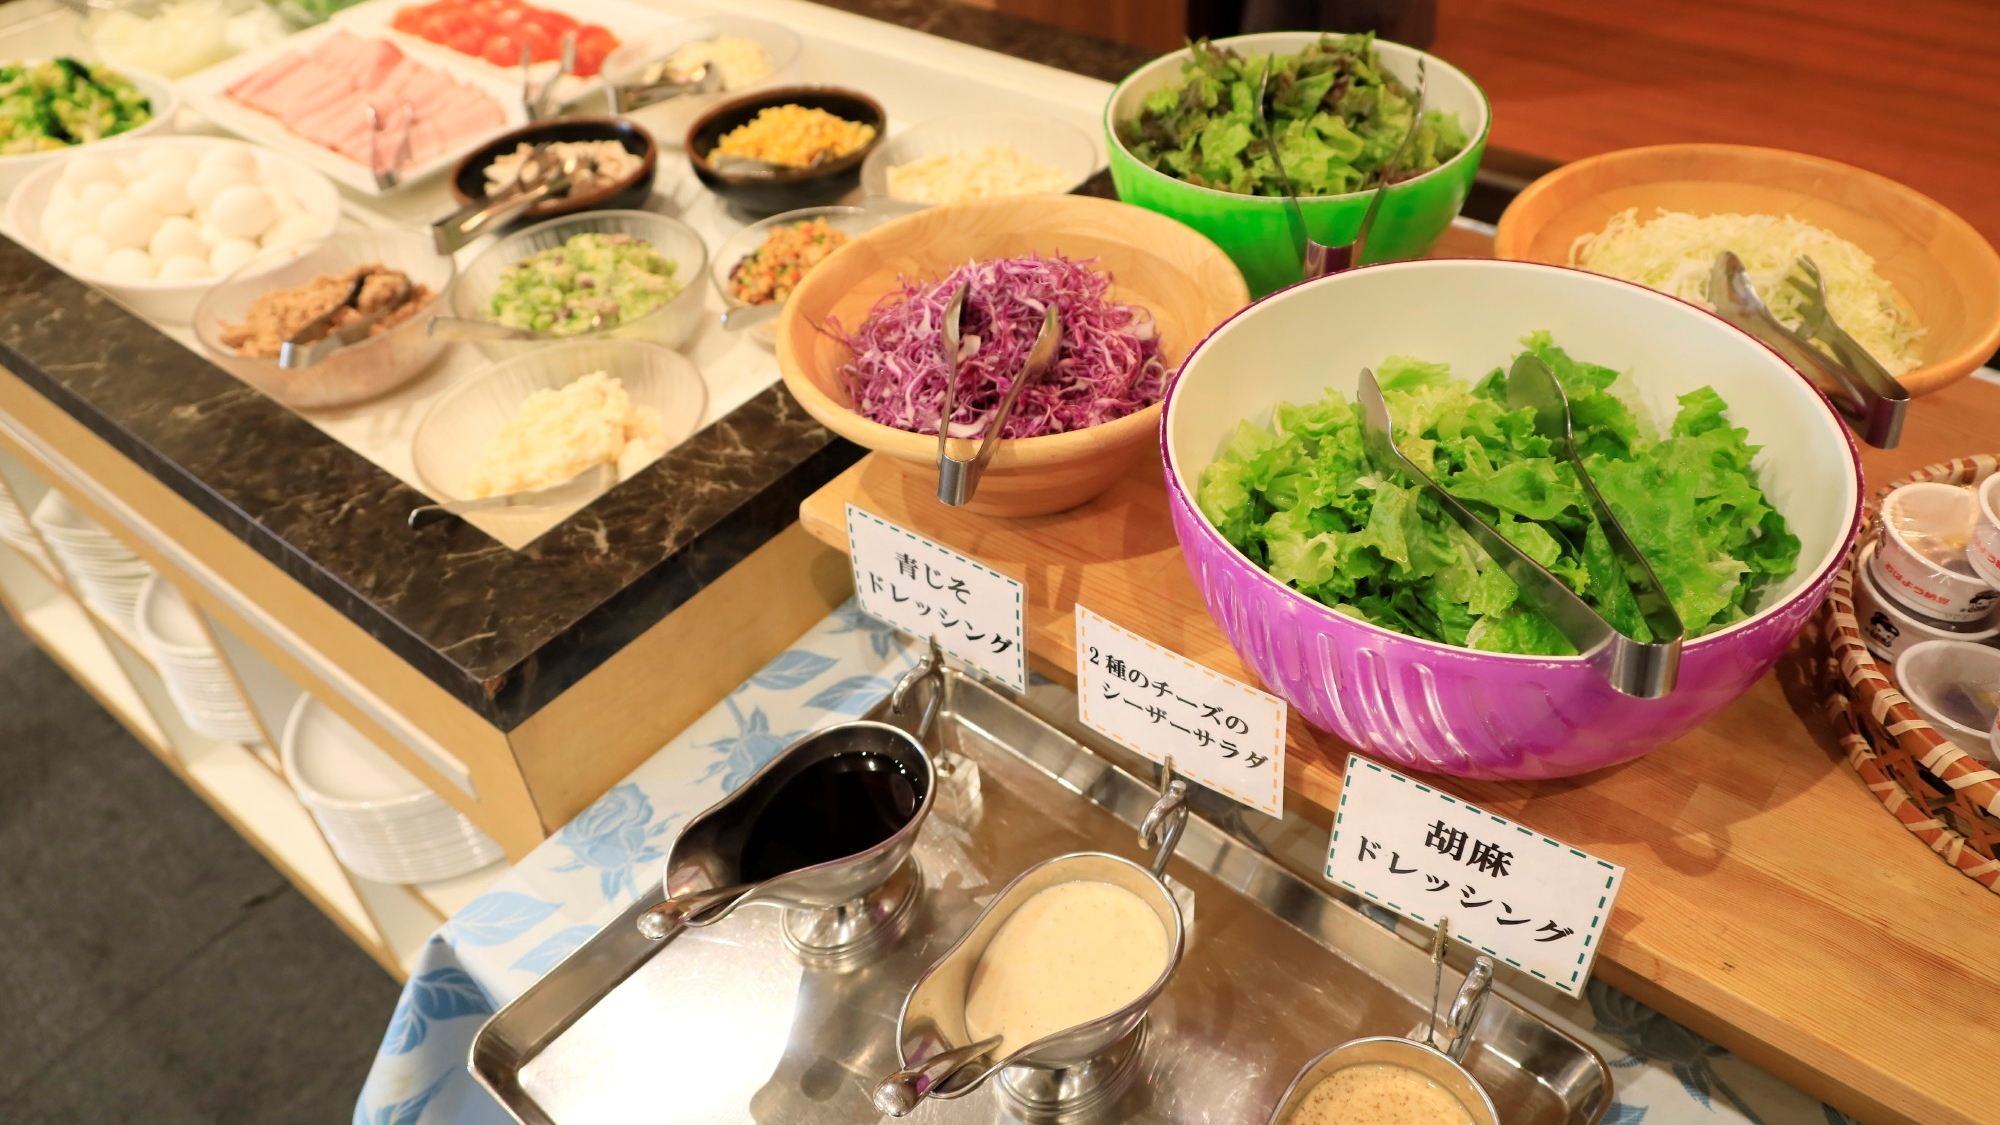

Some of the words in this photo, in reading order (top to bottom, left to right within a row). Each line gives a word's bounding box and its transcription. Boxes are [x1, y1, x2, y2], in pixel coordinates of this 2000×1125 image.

[869, 571, 1013, 653] ドレッシング
[895, 553, 971, 604] 青じそ
[1089, 646, 1249, 735] 2種のチーズの
[1102, 682, 1268, 769] シーザーサラダ
[1357, 835, 1574, 942] ドレッシング
[1424, 820, 1514, 878] 胡麻
